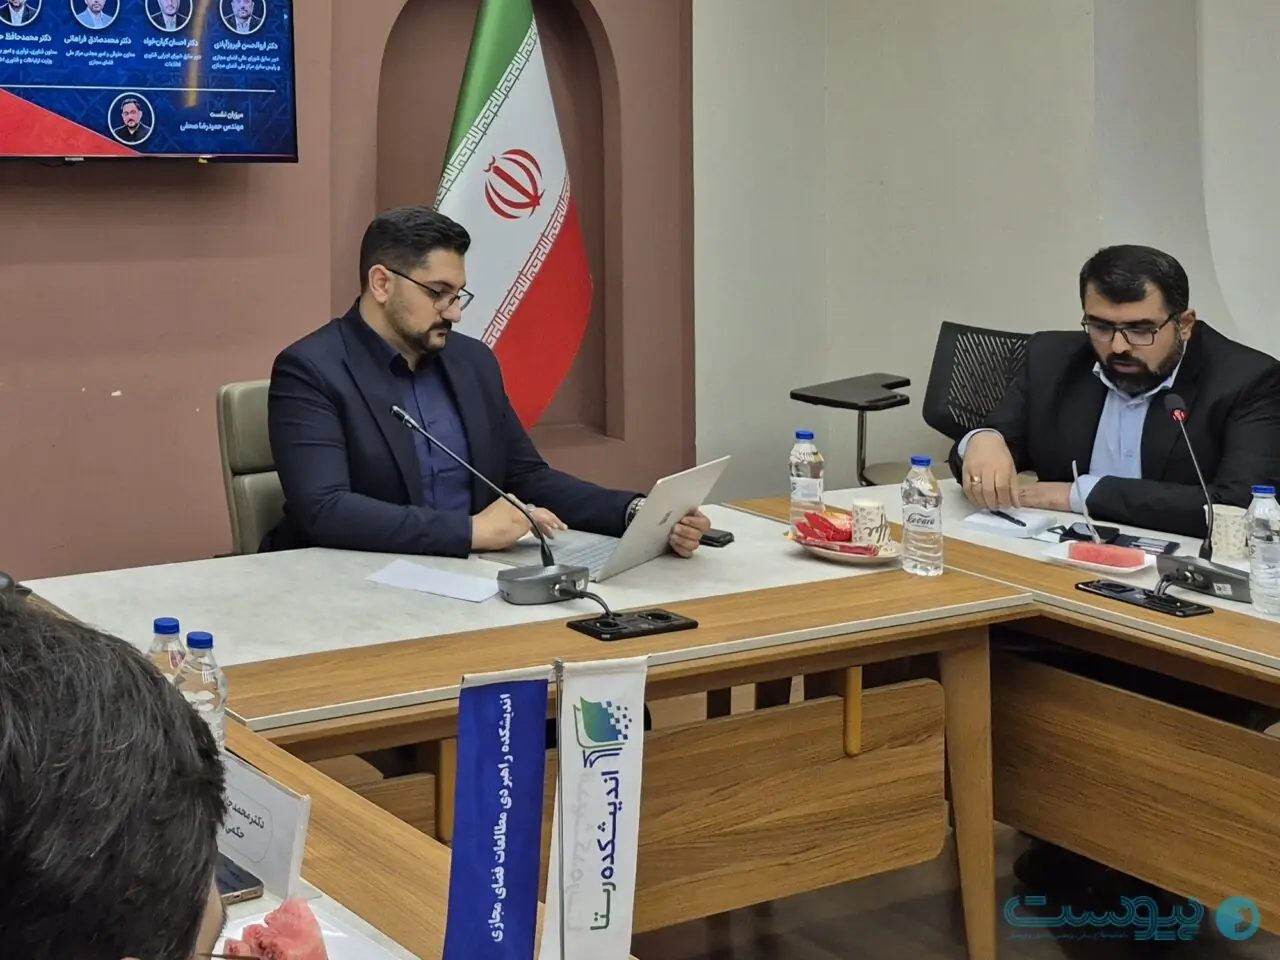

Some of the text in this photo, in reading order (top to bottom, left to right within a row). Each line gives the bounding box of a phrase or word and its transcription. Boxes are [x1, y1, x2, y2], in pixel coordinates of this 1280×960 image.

[39, 34, 52, 43] دکتر
[64, 34, 87, 44] فراهانی
[119, 36, 132, 46] دکتر
[169, 38, 186, 47] احسان
[186, 39, 199, 48] دکتر
[241, 41, 266, 51] ابوالحسن
[266, 41, 278, 51] دکتر
[209, 110, 227, 118] نشست
[222, 122, 244, 132] مهندس
[499, 693, 514, 752] اندیشکده
[493, 812, 507, 863] مطالعات
[491, 866, 506, 899] فضای
[488, 902, 504, 942] مجازی
